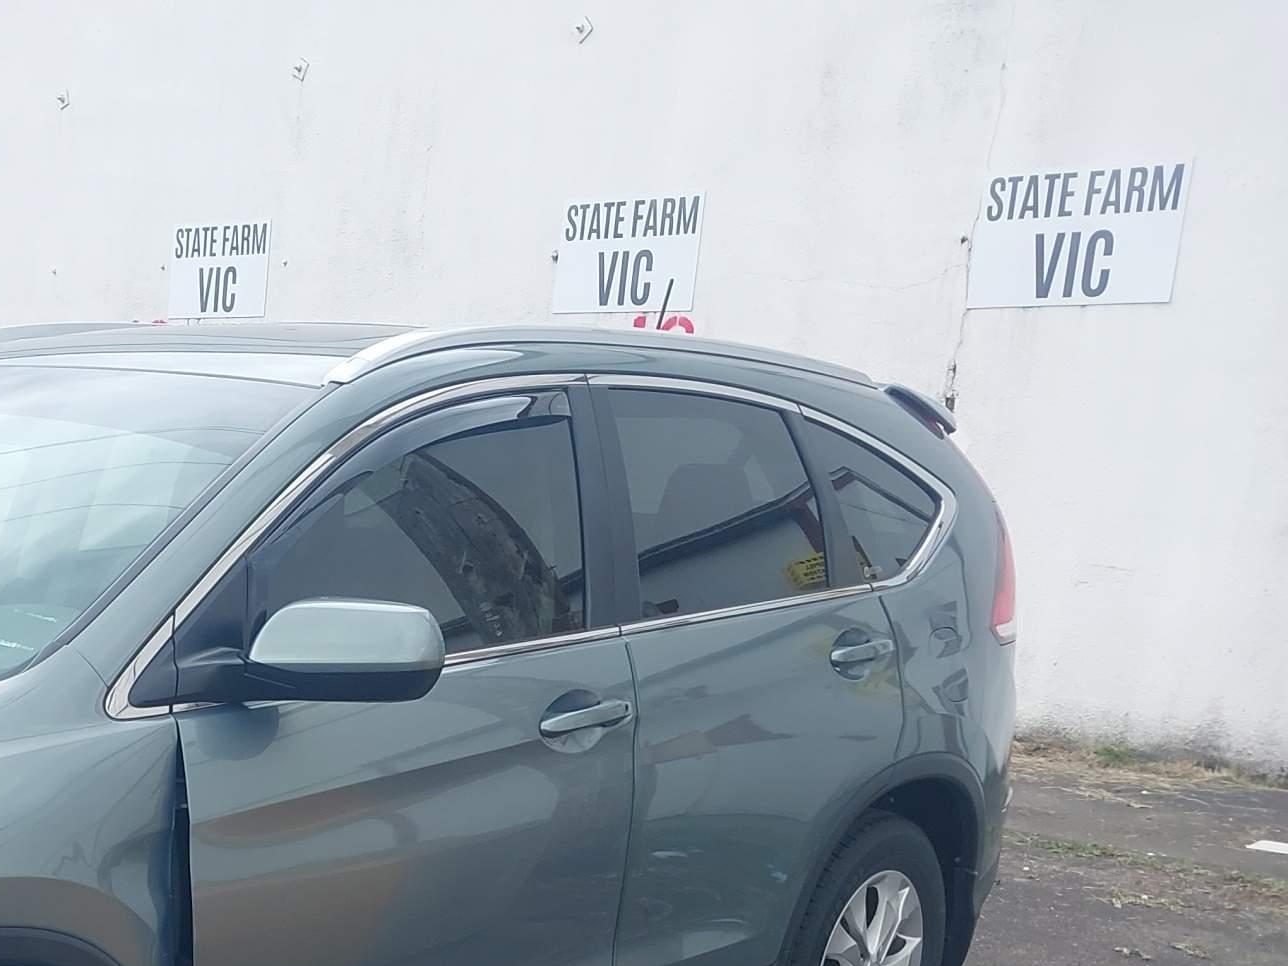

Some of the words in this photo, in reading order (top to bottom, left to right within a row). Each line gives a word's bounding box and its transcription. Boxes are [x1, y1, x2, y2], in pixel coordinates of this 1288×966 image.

[565, 201, 626, 241] STATE
[631, 196, 700, 238] FARM
[987, 172, 1078, 222] STATE
[1083, 163, 1185, 216] FARM
[175, 226, 218, 259] STATE
[222, 223, 268, 256] FARM
[1035, 229, 1114, 298] VIC
[199, 266, 237, 313] VIC
[598, 249, 653, 306] VIC
